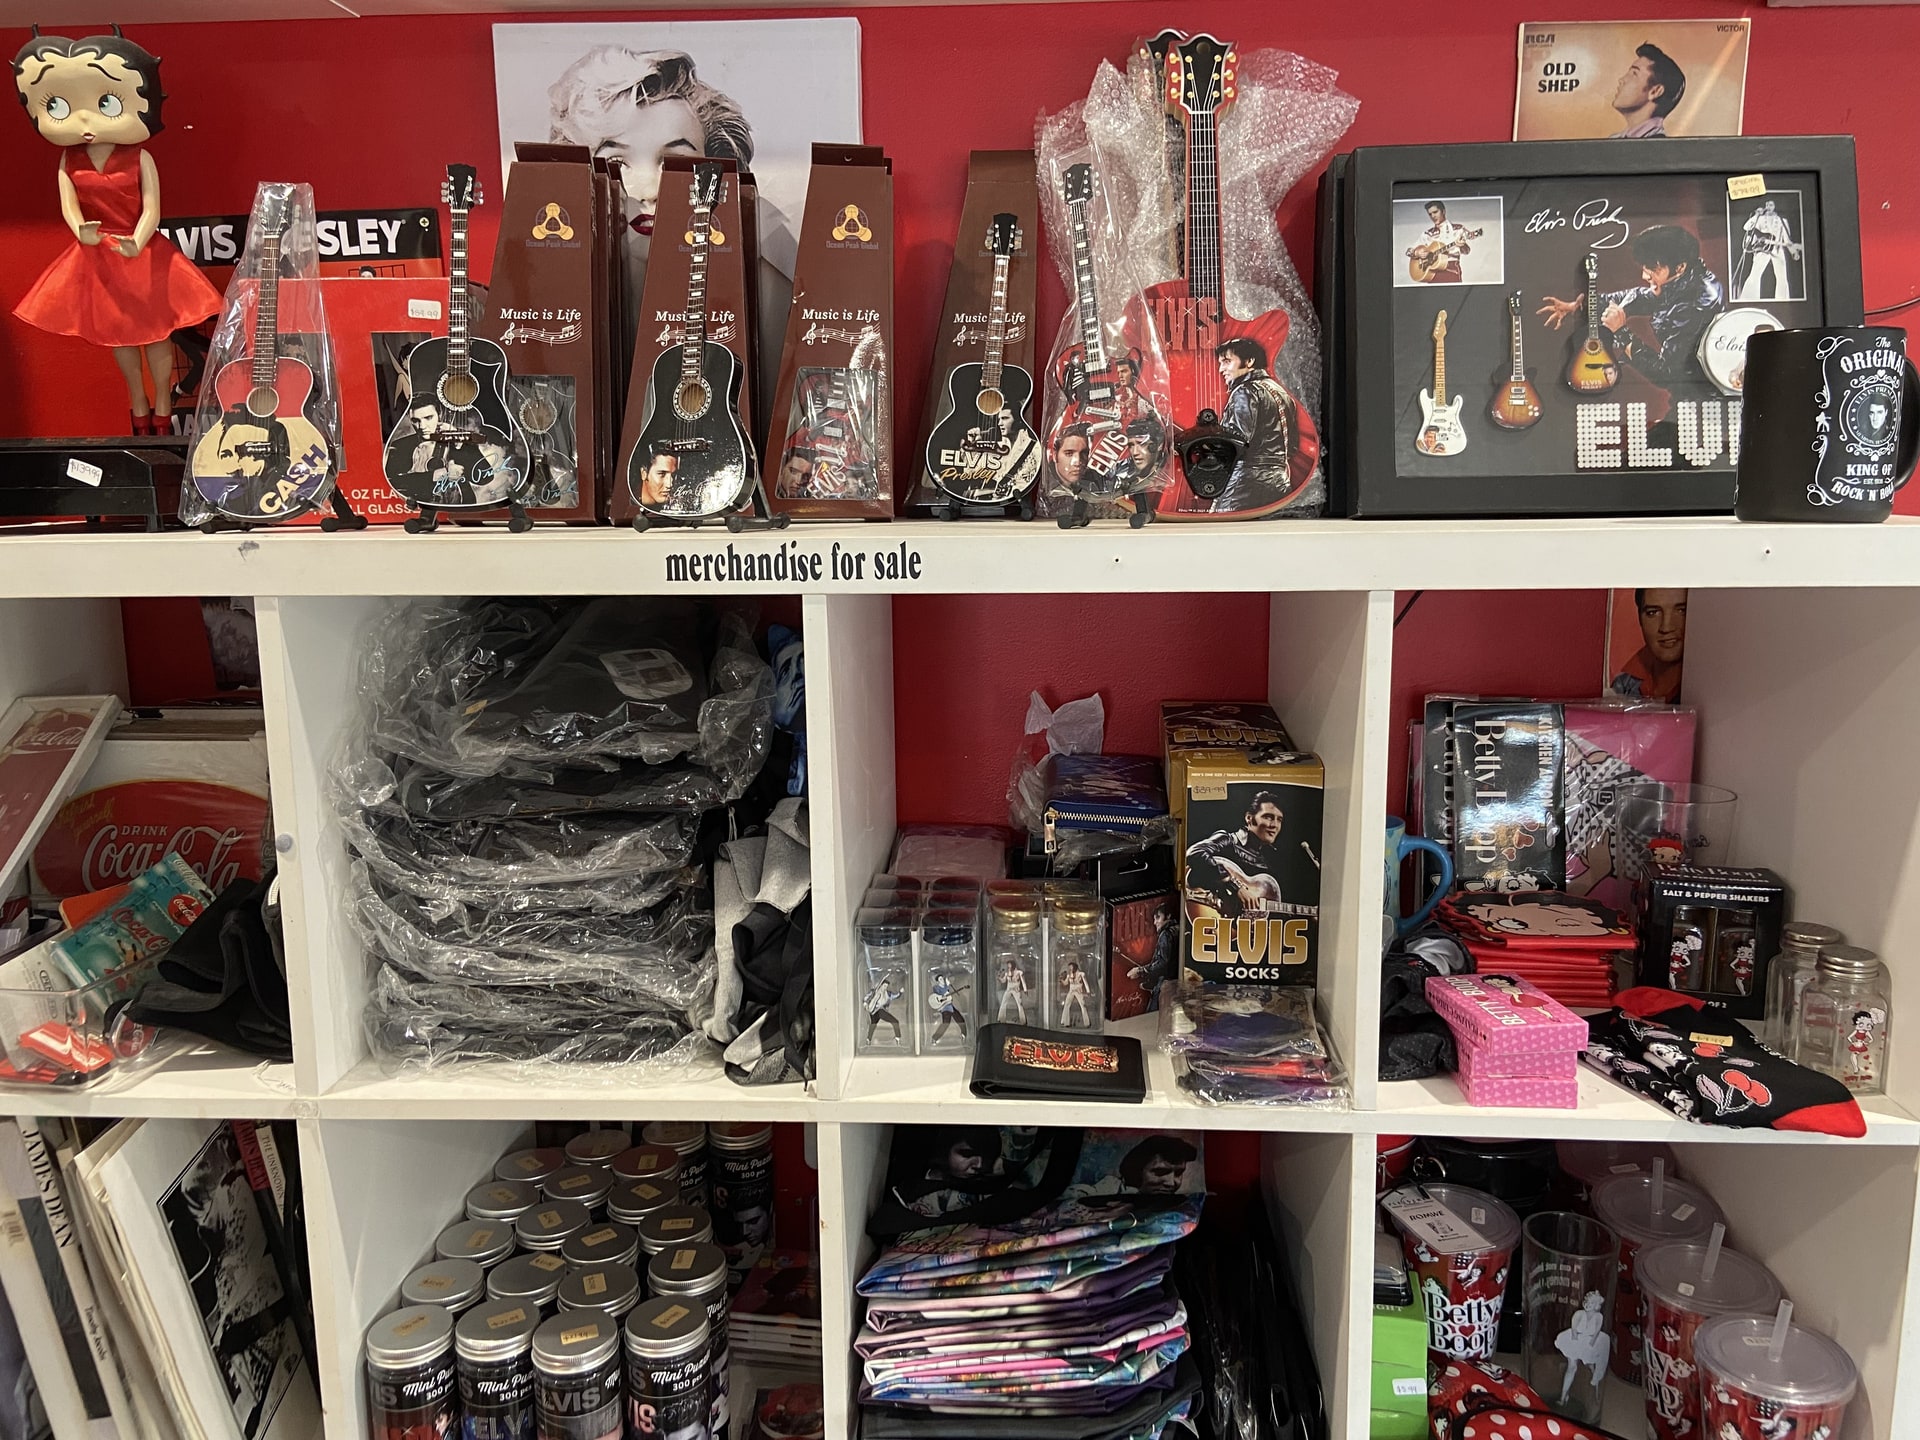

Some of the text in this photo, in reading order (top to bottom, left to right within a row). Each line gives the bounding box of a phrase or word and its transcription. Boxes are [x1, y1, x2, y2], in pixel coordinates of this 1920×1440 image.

[1716, 24, 1745, 33] VICTOR
[1525, 34, 1555, 44] RCA
[1543, 63, 1576, 76] OLD
[1538, 79, 1580, 93] SHEP
[316, 218, 402, 257] SLEY
[500, 308, 581, 322] Music is Life
[655, 310, 735, 323] Musi Life
[802, 308, 880, 323] Music is Life
[953, 312, 1026, 324] Music Life
[1875, 336, 1891, 348] The
[1576, 401, 1743, 468] ELVI
[940, 449, 1002, 470] ELVIS
[1087, 430, 1129, 476] ELVIS
[940, 467, 997, 484] Presley
[1846, 464, 1893, 476] KING OF
[259, 444, 327, 513] CASH
[351, 488, 370, 500] OZ
[1831, 481, 1864, 501] ROCK
[665, 540, 922, 582] merchandise for sale
[1173, 727, 1281, 743] ELVIS
[1464, 717, 1507, 788] Betty
[121, 825, 168, 836] DRINK
[1662, 889, 1683, 897] SALT
[1694, 891, 1728, 900] PEPPER
[1729, 894, 1770, 903] SHAKERS
[1191, 916, 1308, 965] ELVIS
[1225, 966, 1280, 980] SOCKS
[1445, 976, 1528, 1025] BETTY BOOP
[1013, 1043, 1107, 1065] ELVIS
[261, 1135, 273, 1153] THE
[22, 1130, 76, 1248] JAMES DEAN
[1409, 1210, 1446, 1221] ROMWE
[1426, 1292, 1501, 1326] Betty
[1427, 1321, 1497, 1358] Boop
[402, 1375, 436, 1397] Mini
[477, 1377, 510, 1395] Mini
[651, 1371, 683, 1385] Mini
[672, 1373, 703, 1391] 300 pcs
[426, 1388, 443, 1401] 300
[499, 1390, 518, 1401] 300
